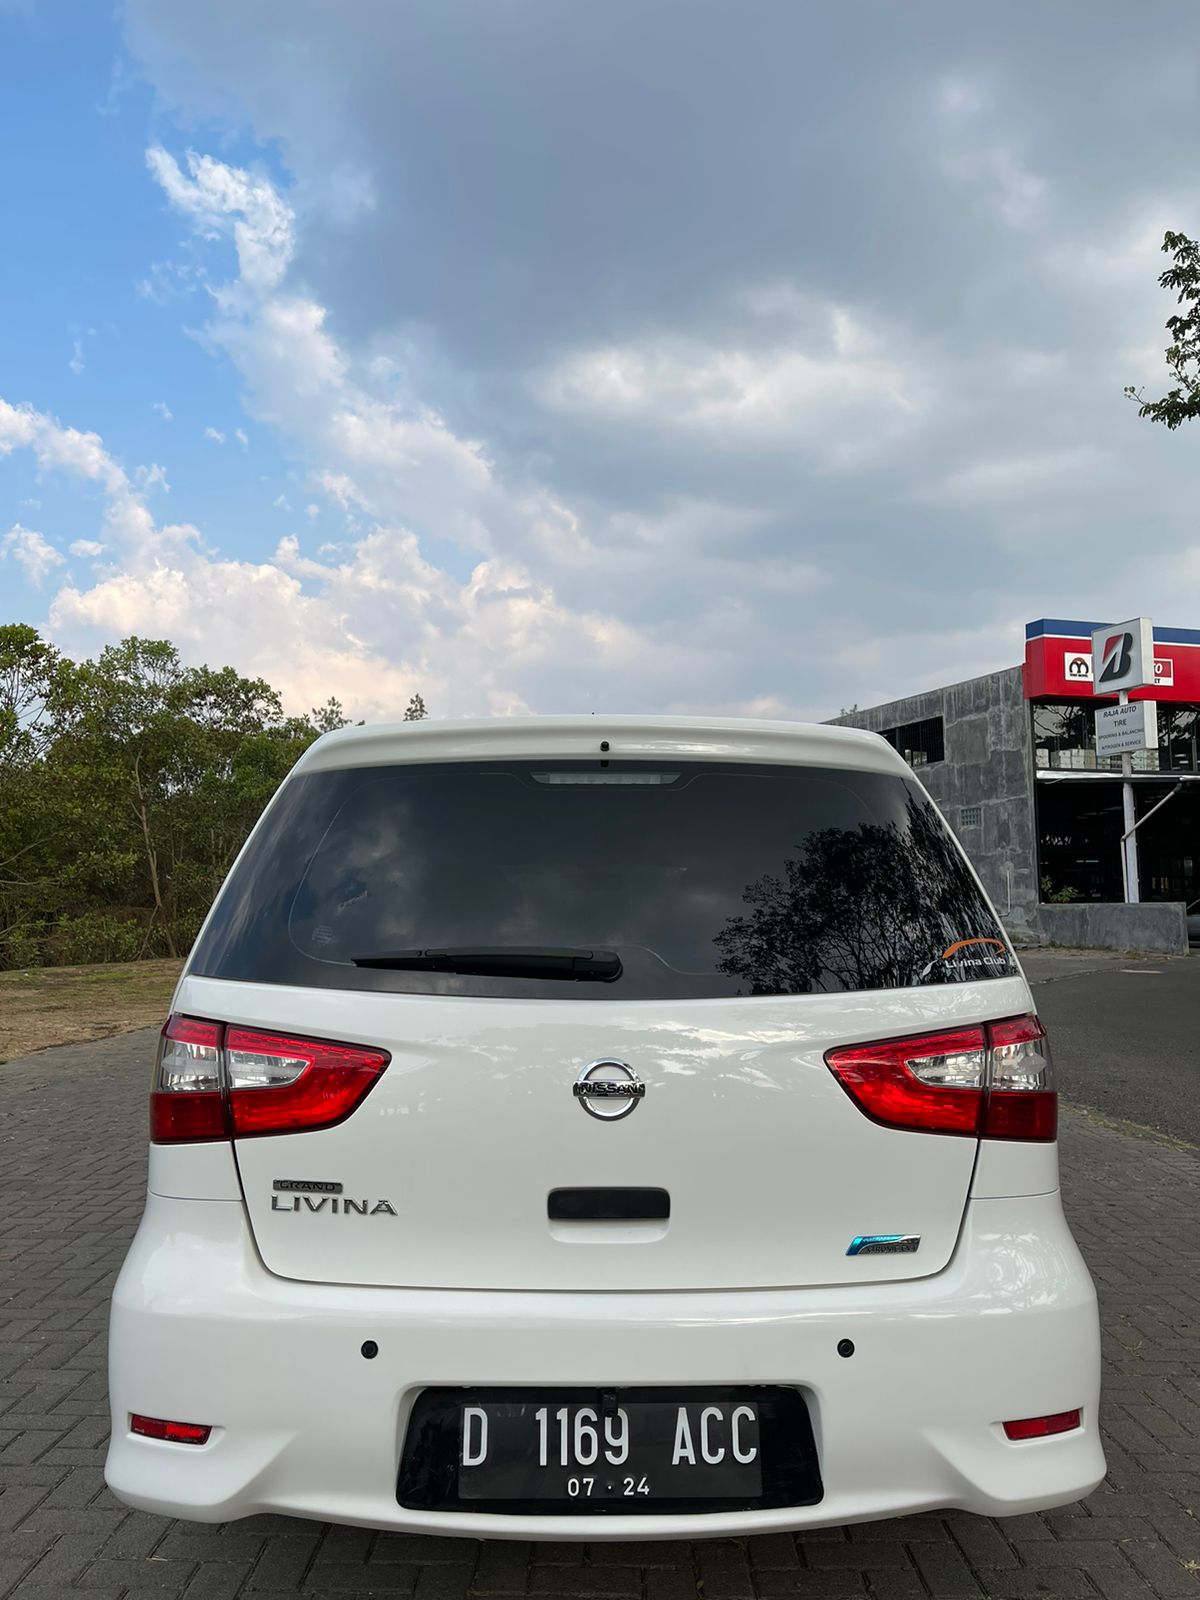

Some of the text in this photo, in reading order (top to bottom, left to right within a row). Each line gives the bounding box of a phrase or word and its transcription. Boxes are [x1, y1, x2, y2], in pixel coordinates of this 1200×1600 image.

[1103, 705, 1137, 718] RAJA AUTO
[1113, 718, 1127, 727] TIRE
[983, 956, 1006, 965] Club
[580, 1082, 638, 1094] NISSAN
[279, 1180, 336, 1192] GRAND
[271, 1194, 398, 1216] LIVINA
[462, 1406, 758, 1466] D 1169 ACC
[567, 1477, 650, 1497] 07 24
